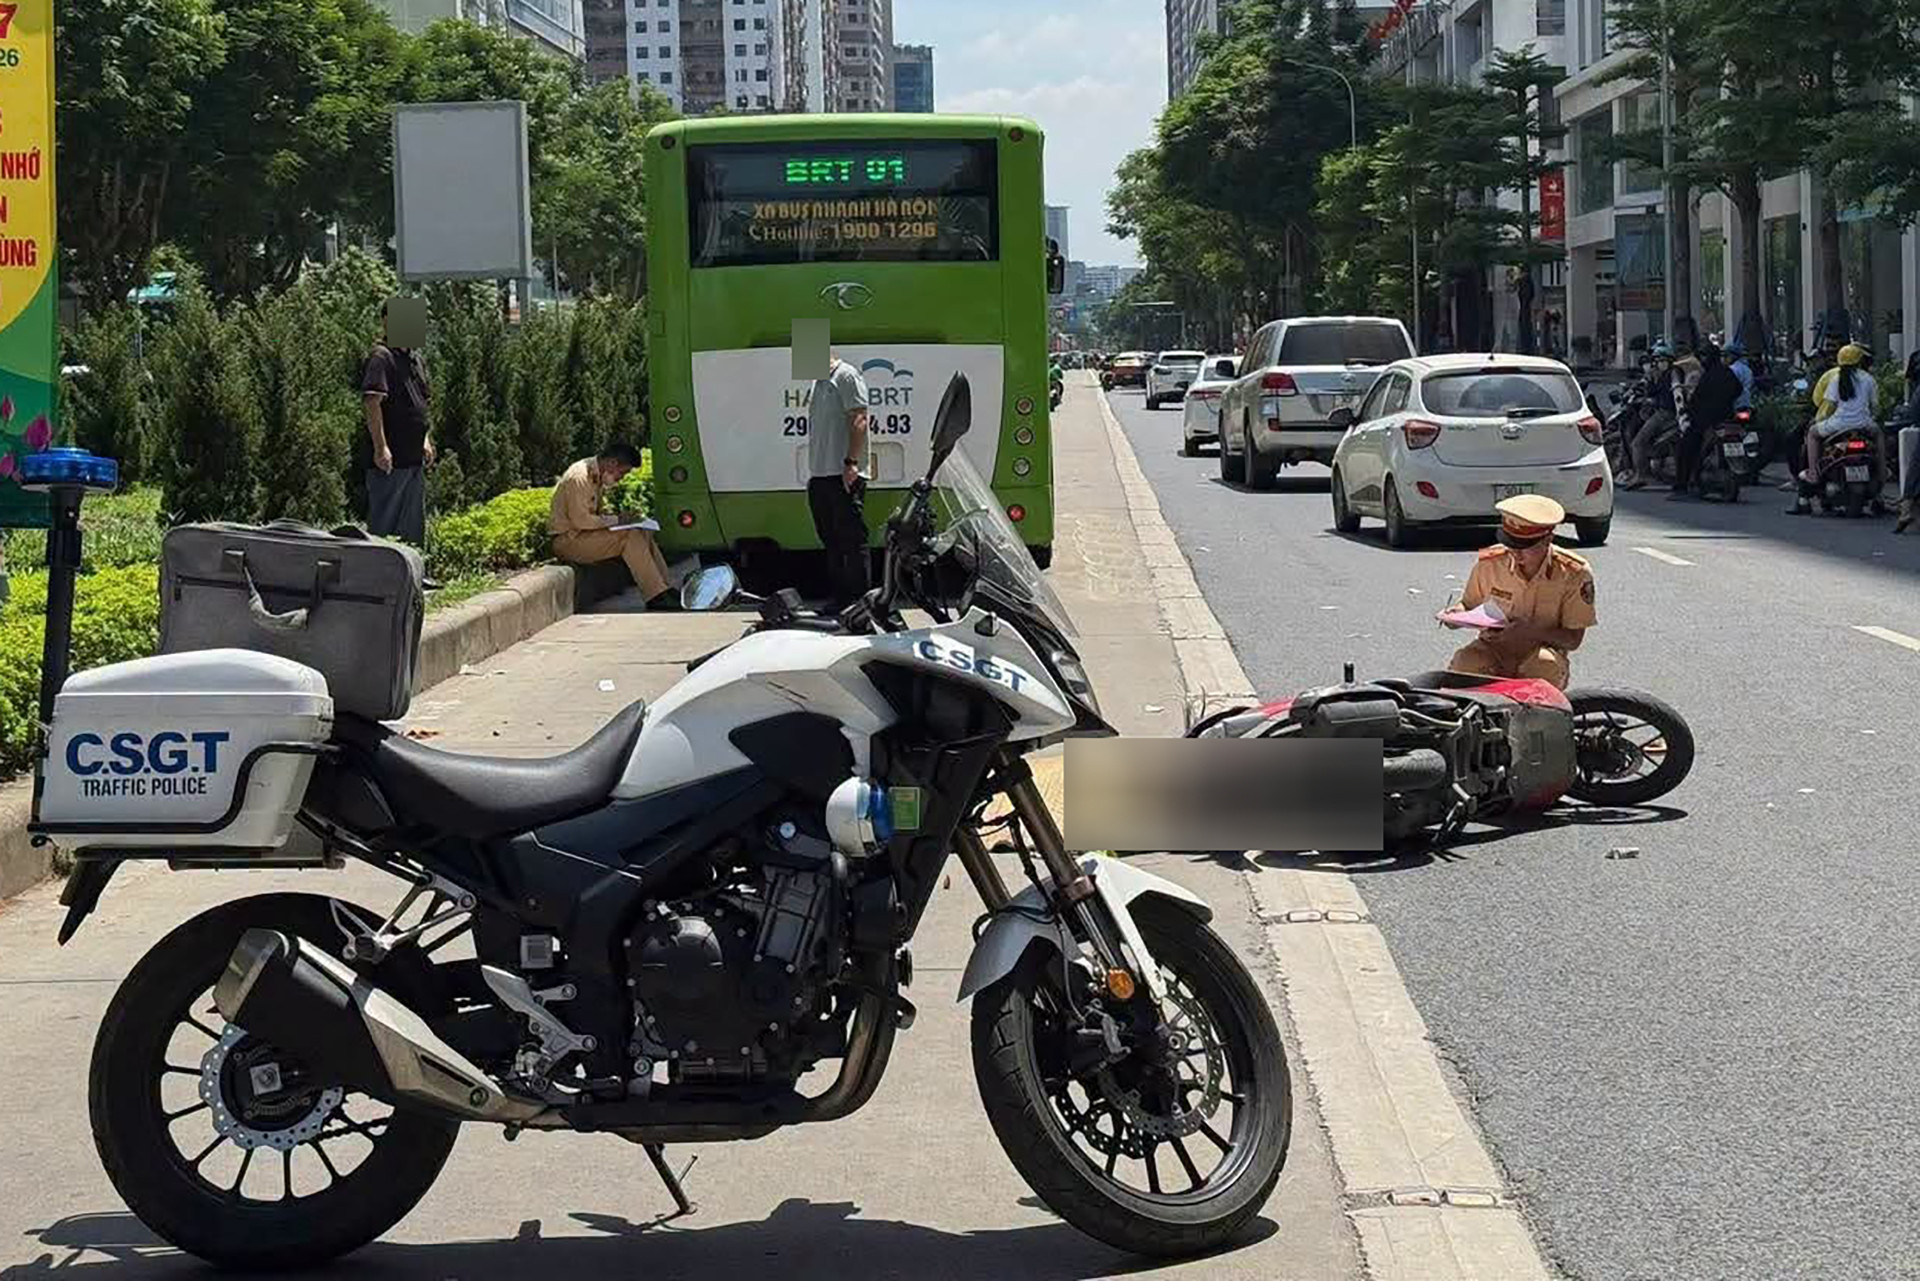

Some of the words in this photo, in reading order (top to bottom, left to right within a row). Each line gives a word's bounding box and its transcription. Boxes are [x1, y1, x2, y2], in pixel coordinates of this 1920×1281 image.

[1, 146, 41, 181] NHỚ
[786, 160, 855, 182] BRT
[866, 160, 904, 182] 01
[779, 201, 809, 219] BUS
[874, 196, 898, 217] HÀ
[830, 222, 881, 239] 1900
[868, 387, 913, 406] BRT
[66, 731, 230, 776] C.S.G.T
[82, 778, 146, 797] TRAFFIC
[151, 776, 207, 795] POLICE
